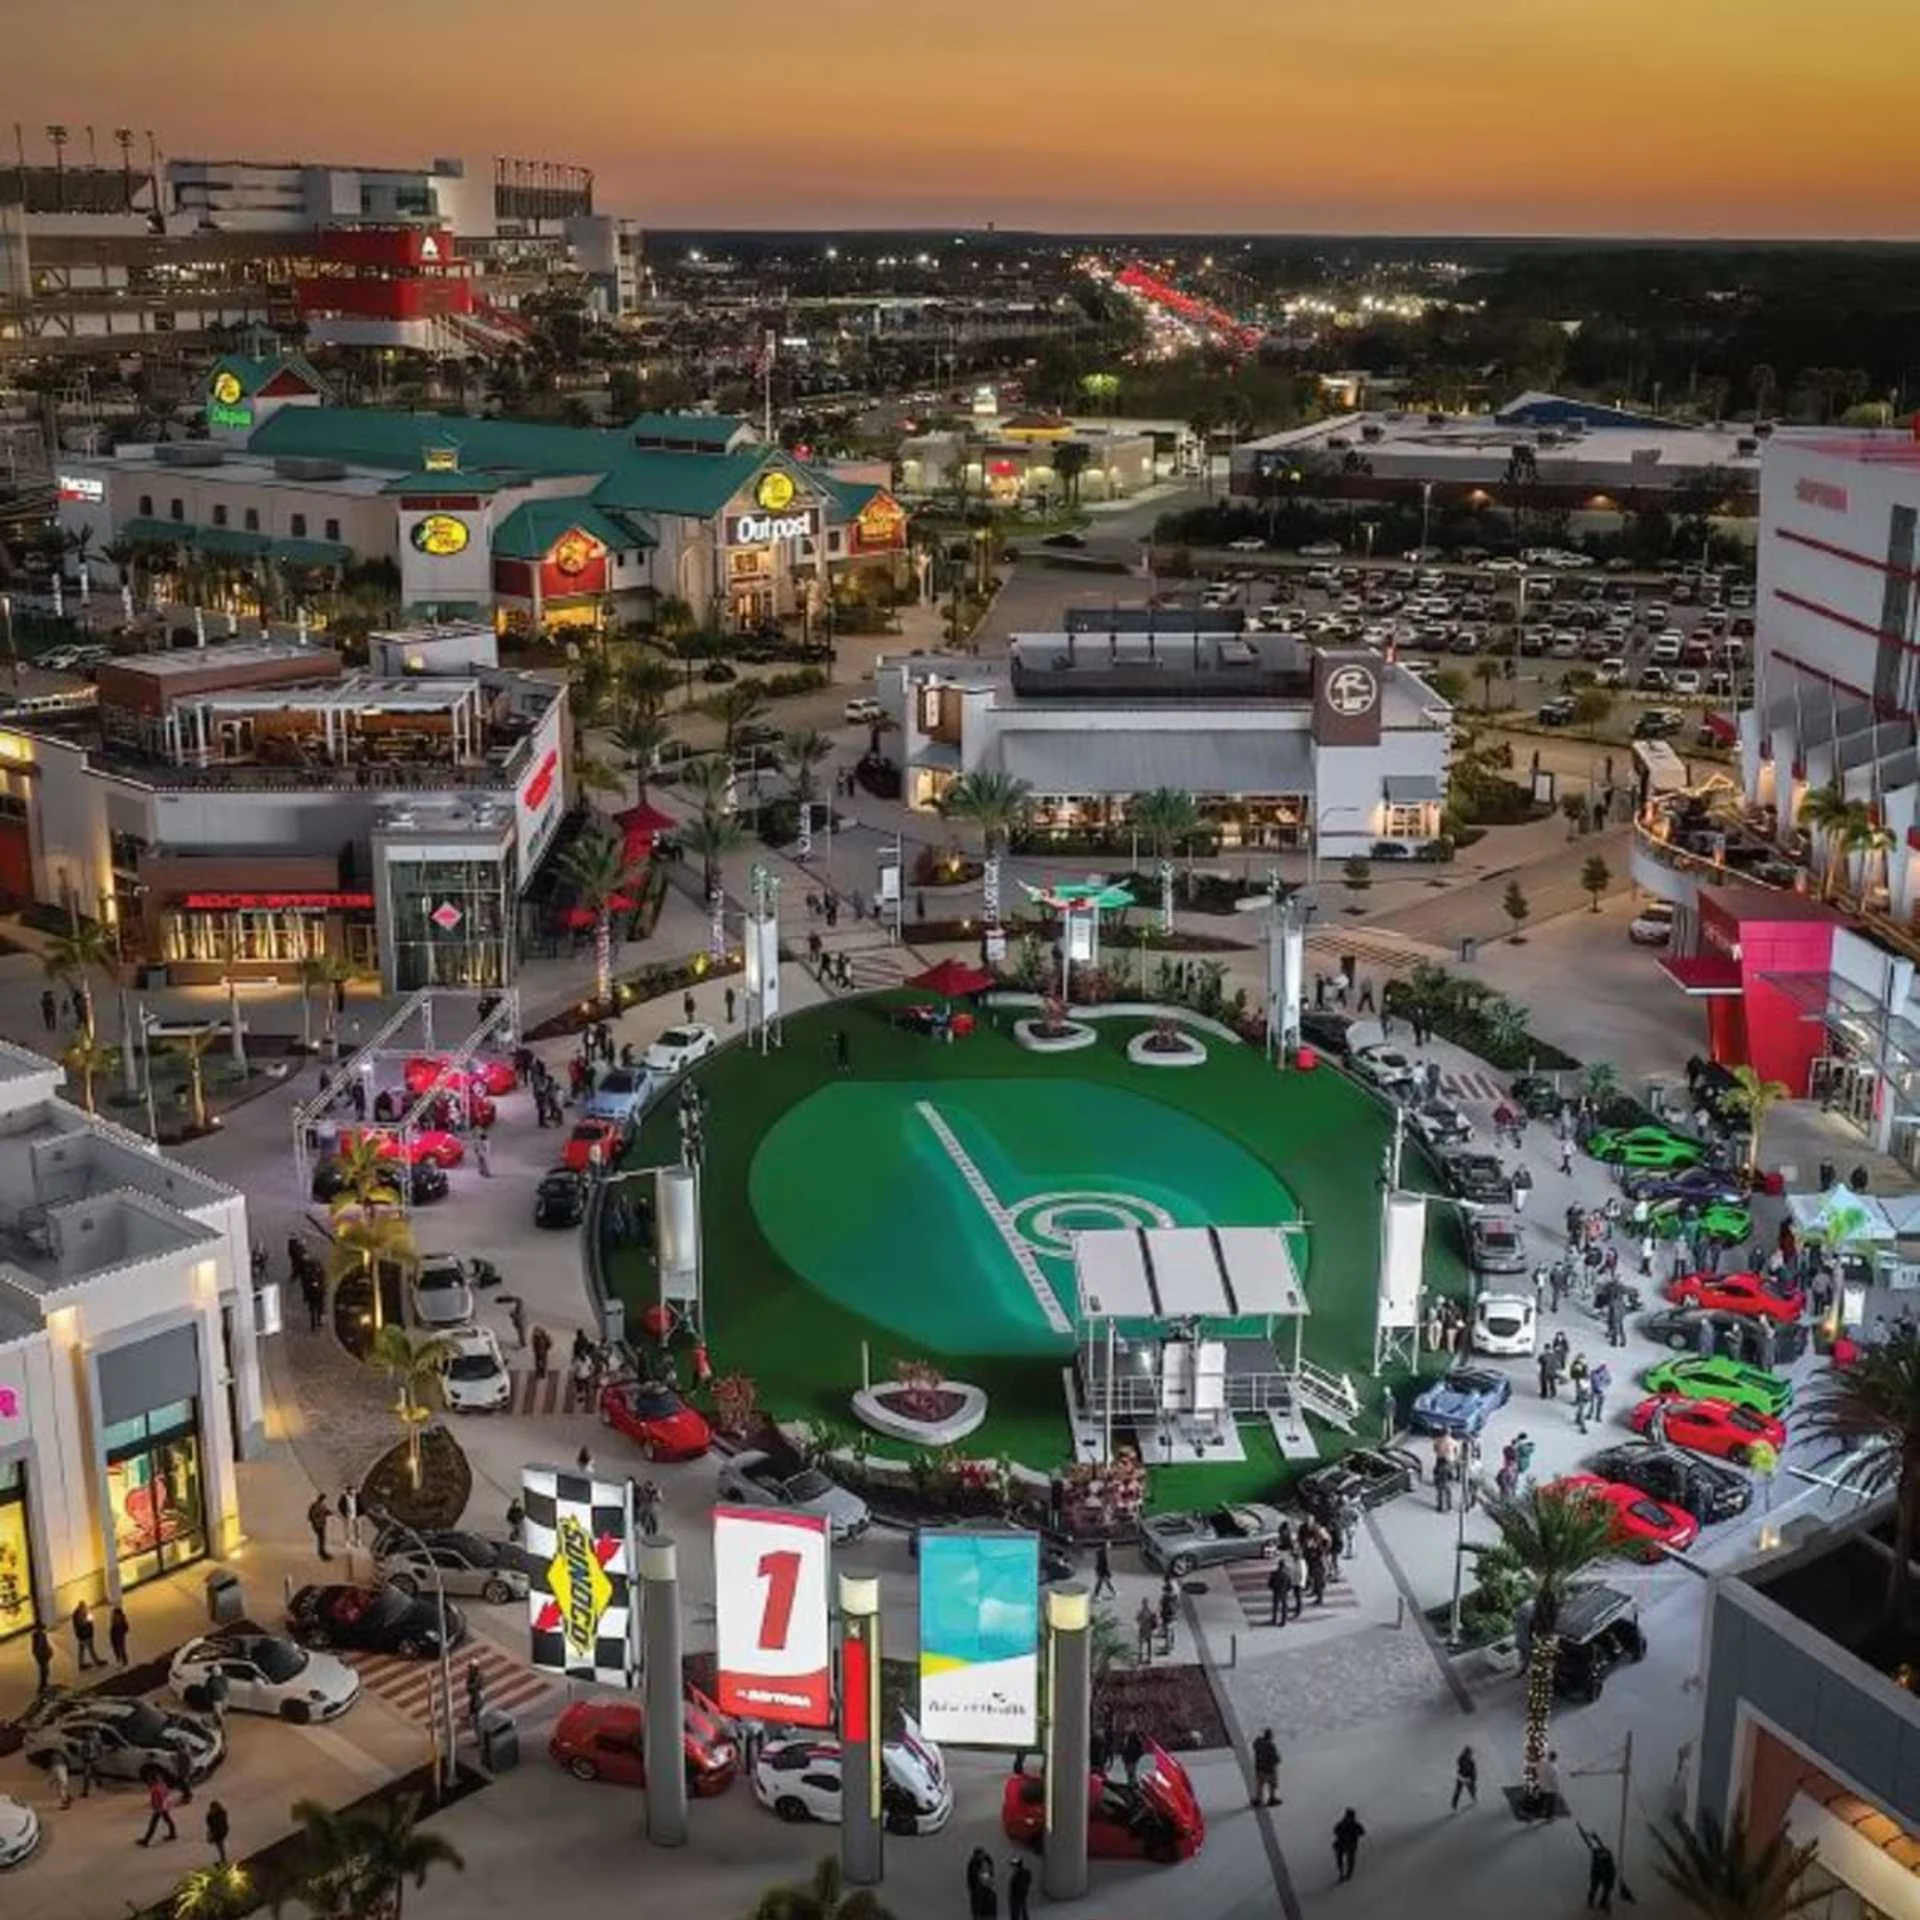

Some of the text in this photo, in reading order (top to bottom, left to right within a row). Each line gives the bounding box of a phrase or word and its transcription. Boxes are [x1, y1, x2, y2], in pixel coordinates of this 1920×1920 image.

[738, 512, 811, 545] Outpost
[565, 1530, 592, 1647] SUNOCO
[757, 1550, 802, 1650] 1
